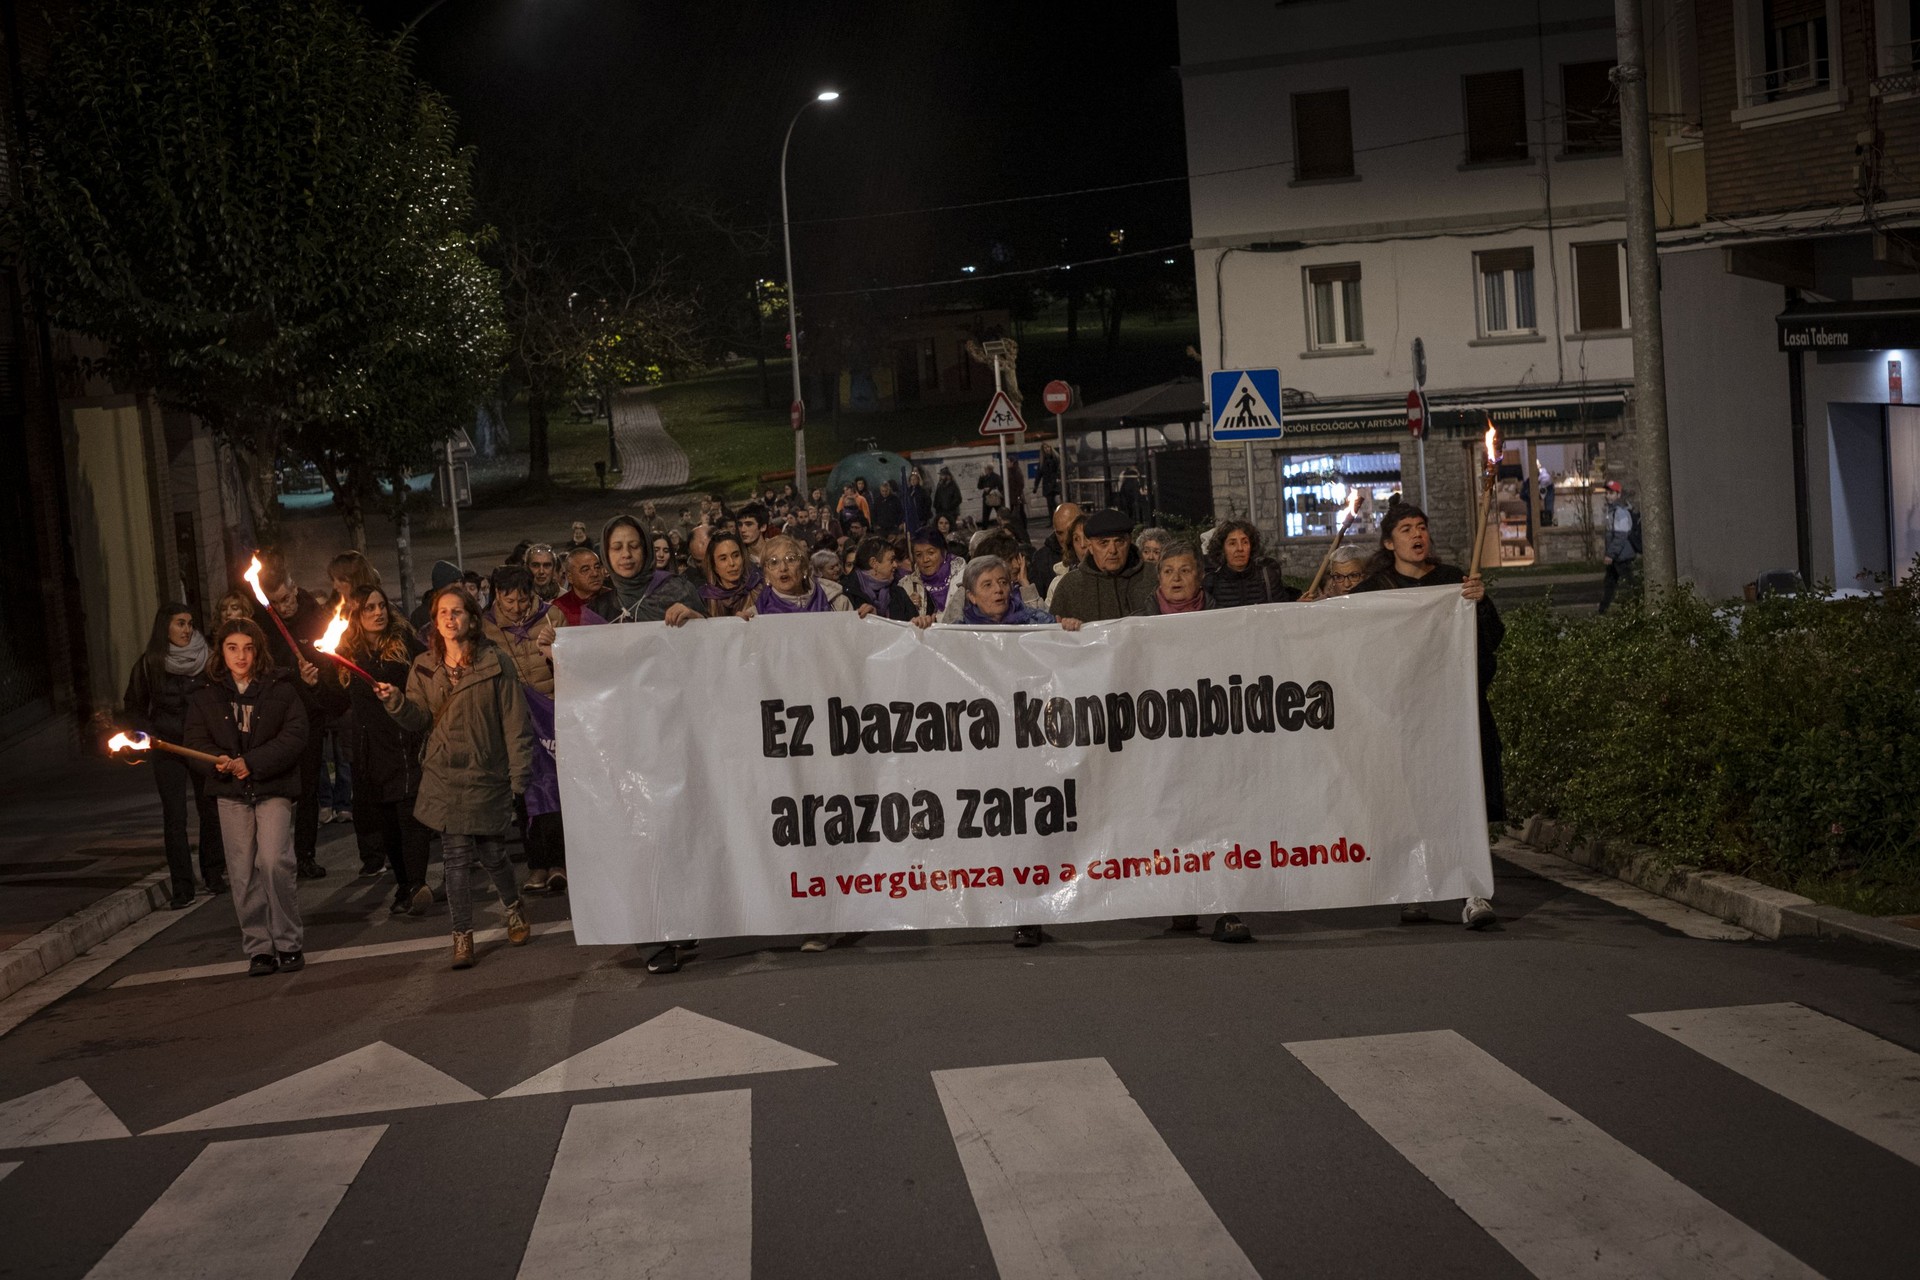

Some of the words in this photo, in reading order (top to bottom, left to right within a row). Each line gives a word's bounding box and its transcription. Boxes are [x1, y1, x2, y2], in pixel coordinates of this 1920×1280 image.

[1784, 327, 1810, 346] Lasai
[1811, 326, 1849, 346] Taberna
[1311, 420, 1360, 432] ECOLÓGICA
[1360, 420, 1367, 430] Y
[761, 699, 814, 758] Ez
[828, 696, 1000, 756] bazara
[1014, 674, 1335, 752] konponbidea
[771, 789, 945, 847] arazoa
[956, 778, 1078, 839] zara!
[790, 871, 827, 898] La
[836, 864, 1004, 899] vergüenza
[1013, 864, 1050, 886] va
[1059, 863, 1077, 883] a
[1087, 848, 1216, 880] cambiar
[1224, 843, 1262, 870] de
[1270, 837, 1371, 868] bando.
